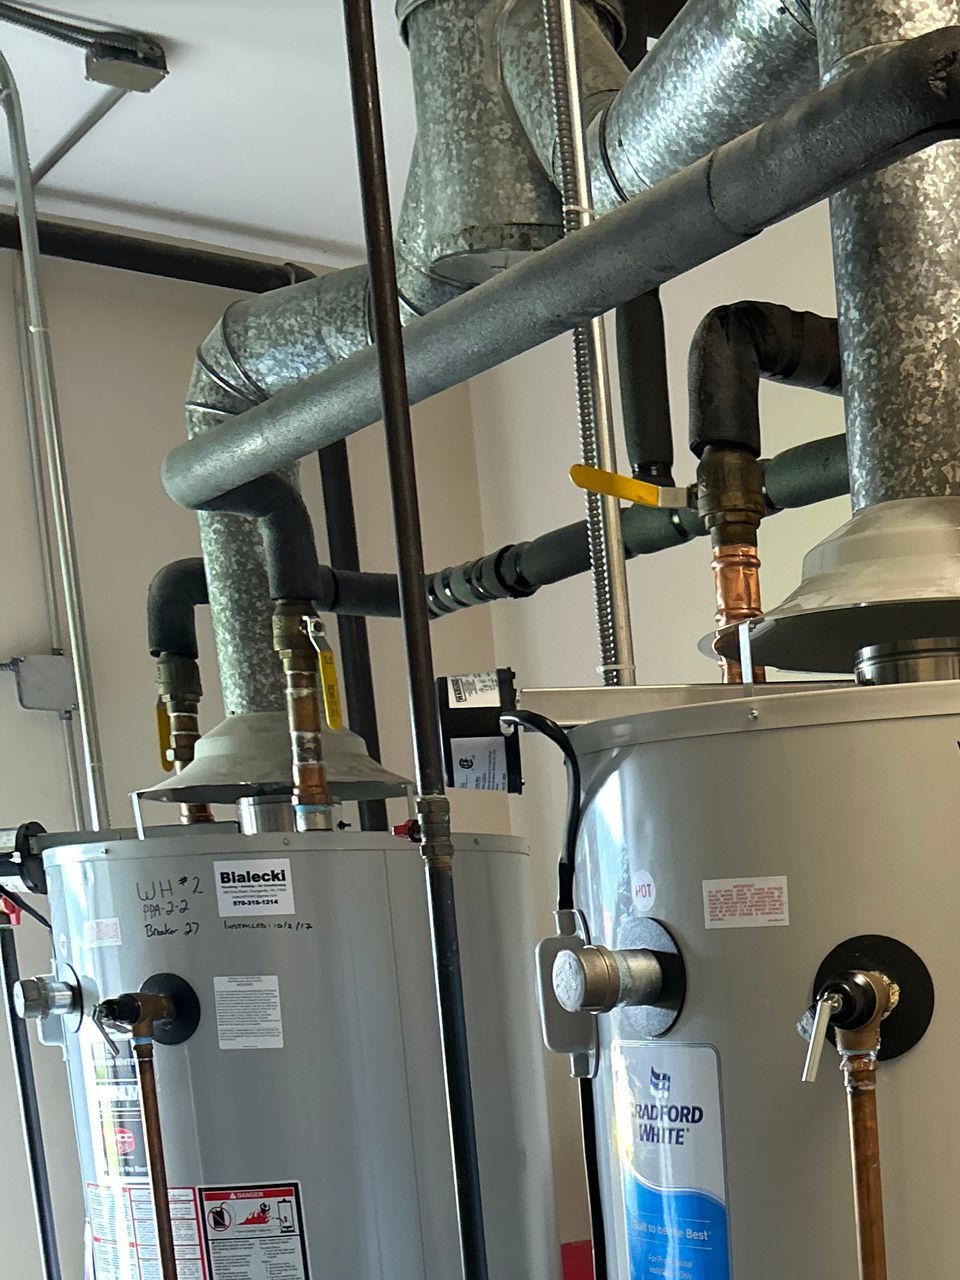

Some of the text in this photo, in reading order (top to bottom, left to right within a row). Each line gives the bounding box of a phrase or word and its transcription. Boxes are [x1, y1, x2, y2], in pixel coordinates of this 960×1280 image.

[220, 870, 286, 884] Bialecki
[136, 881, 174, 902] WH
[635, 884, 652, 898] HOT
[632, 1104, 704, 1125] RADFORD
[639, 1124, 685, 1146] WHITE
[686, 1229, 708, 1240] Best
